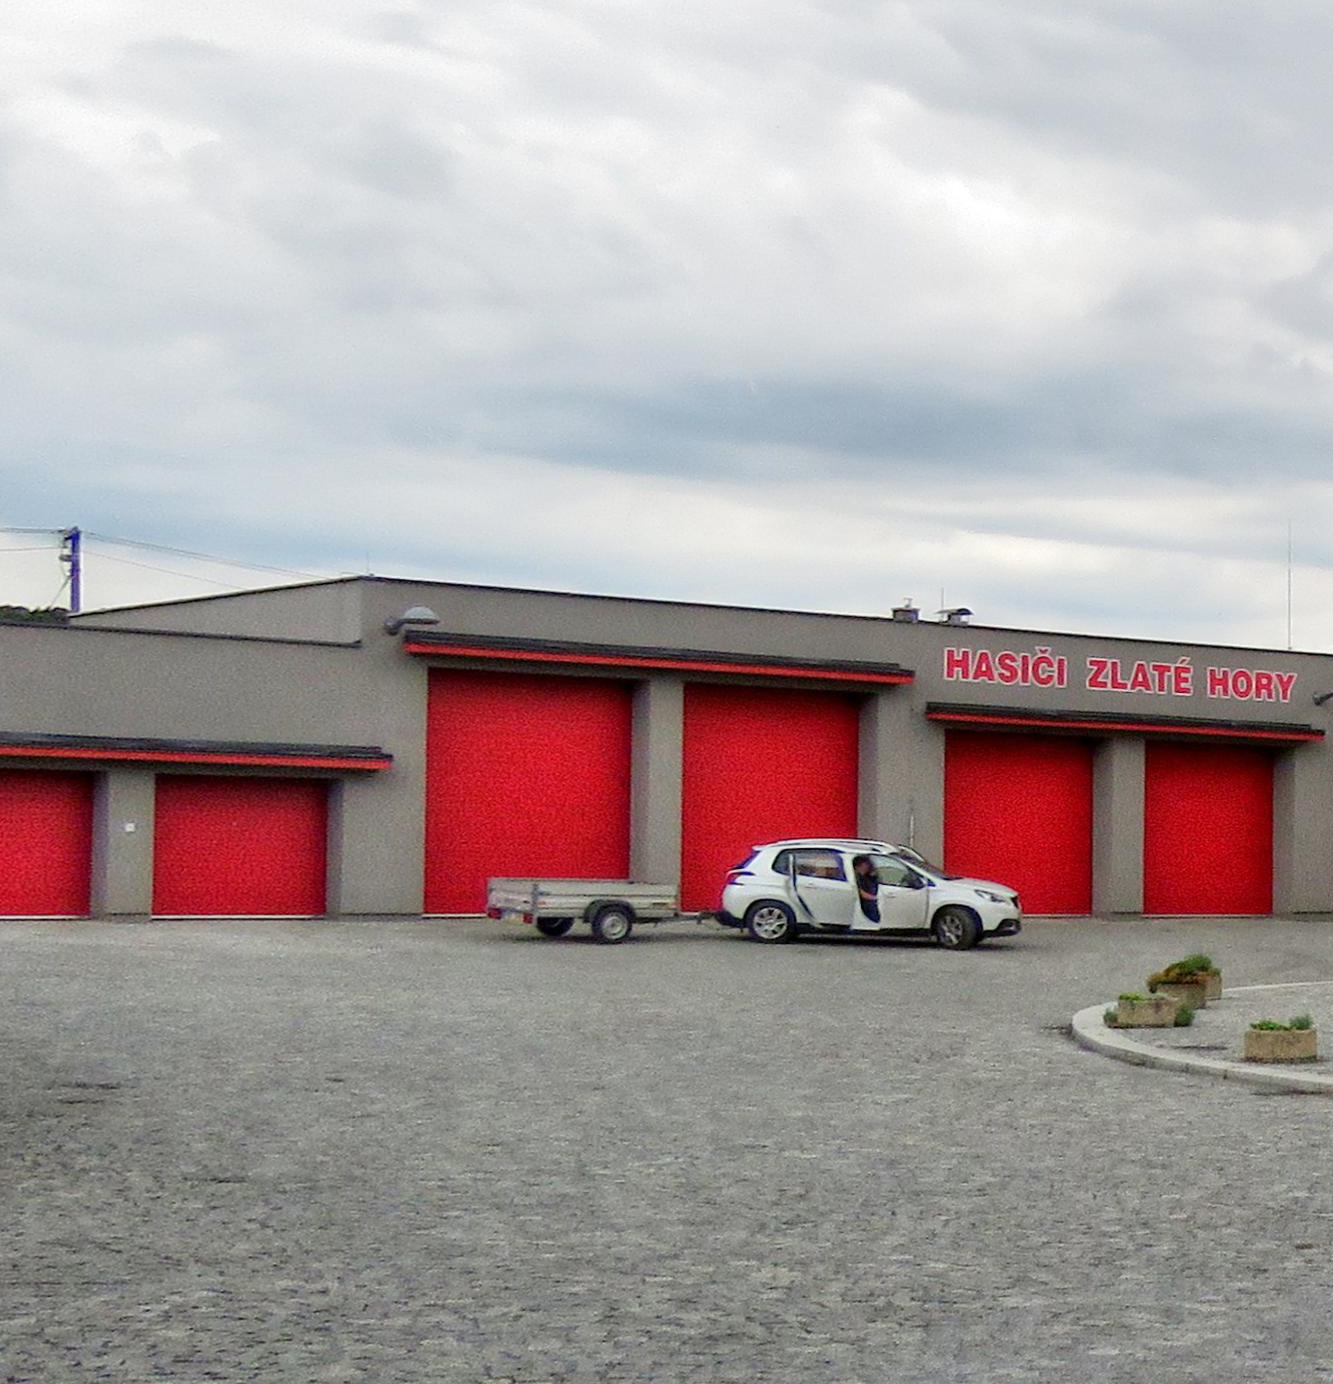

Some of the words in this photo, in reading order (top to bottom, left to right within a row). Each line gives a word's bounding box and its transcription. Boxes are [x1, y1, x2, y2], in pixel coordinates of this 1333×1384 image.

[944, 647, 1067, 688] HASIČI
[1086, 657, 1194, 696] ZLATÉ
[1207, 667, 1298, 701] HORY
